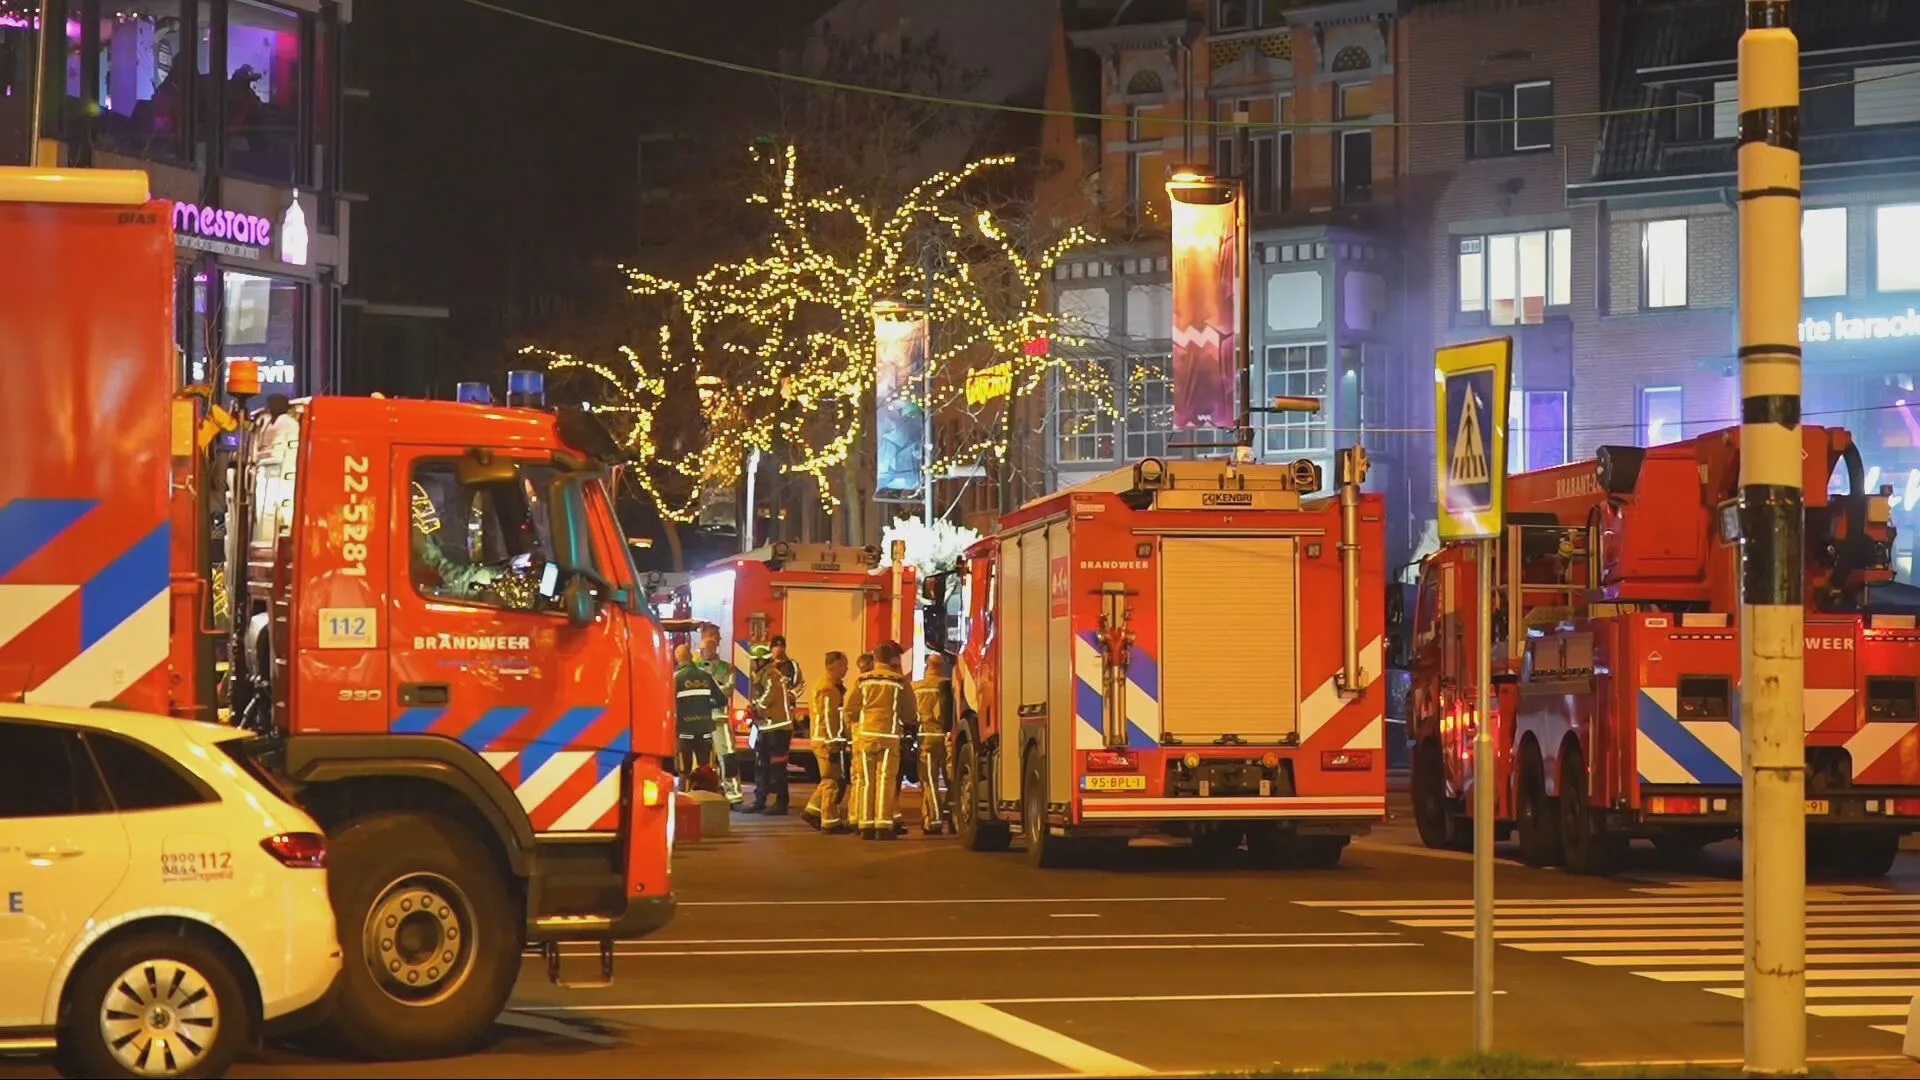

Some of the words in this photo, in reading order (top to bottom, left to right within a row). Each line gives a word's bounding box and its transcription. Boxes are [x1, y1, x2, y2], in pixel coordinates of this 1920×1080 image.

[172, 201, 271, 247] mestate
[341, 455, 369, 577] 22-5281
[1080, 560, 1149, 569] BRANDWEER
[330, 616, 366, 636] 112
[413, 634, 530, 650] BRANDWEER
[1804, 637, 1855, 650] WEER
[199, 851, 233, 870] 112
